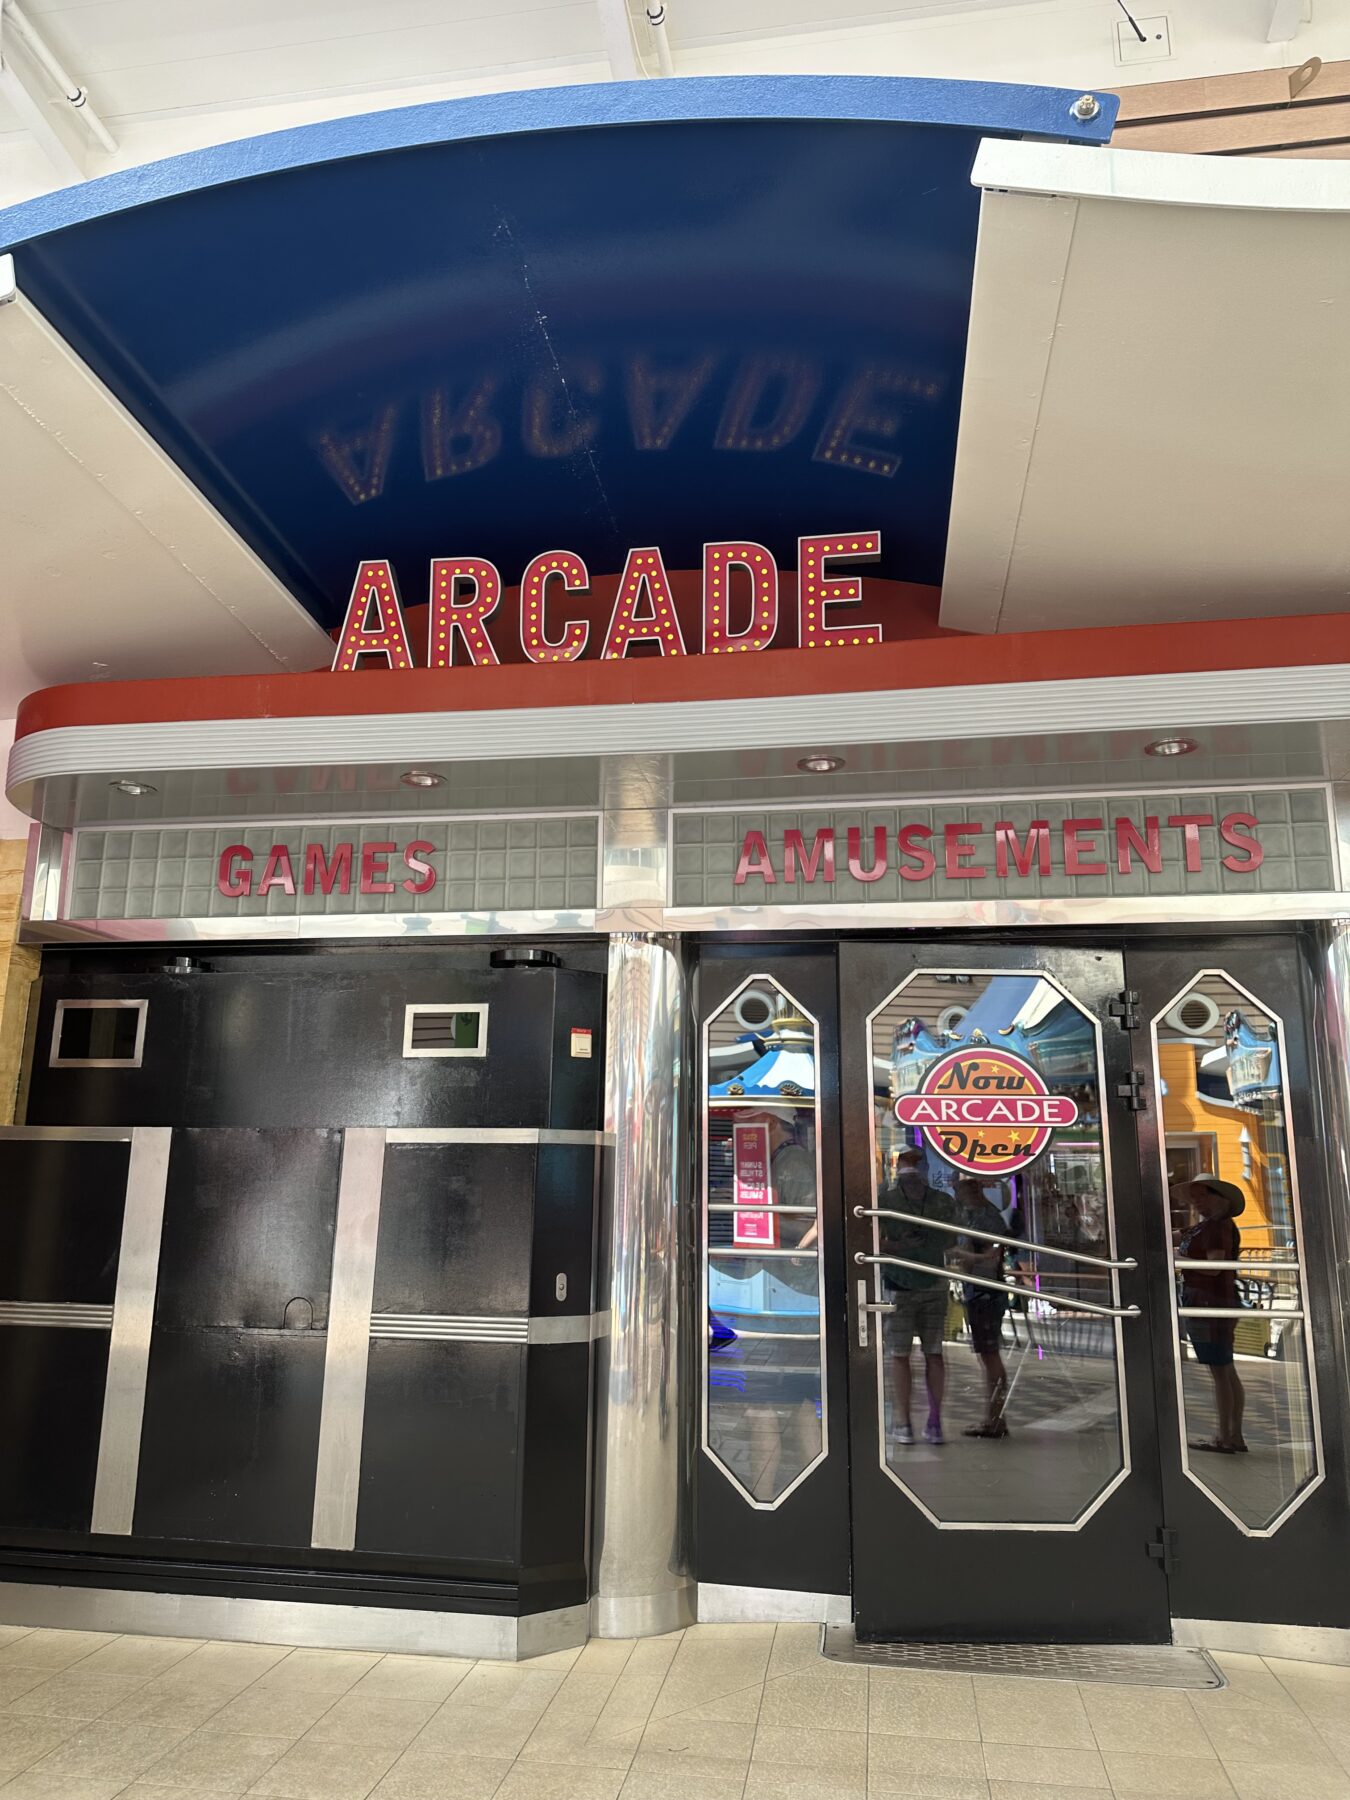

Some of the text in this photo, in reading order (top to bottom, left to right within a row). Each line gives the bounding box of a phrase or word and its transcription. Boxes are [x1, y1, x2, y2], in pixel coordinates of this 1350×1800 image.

[331, 530, 882, 671] ARCADE
[217, 840, 437, 897] GAMES
[733, 812, 1265, 885] AMUSEMENTS
[937, 1062, 1025, 1090] Now
[910, 1099, 1062, 1122] ARCADE
[938, 1131, 1036, 1162] Open
